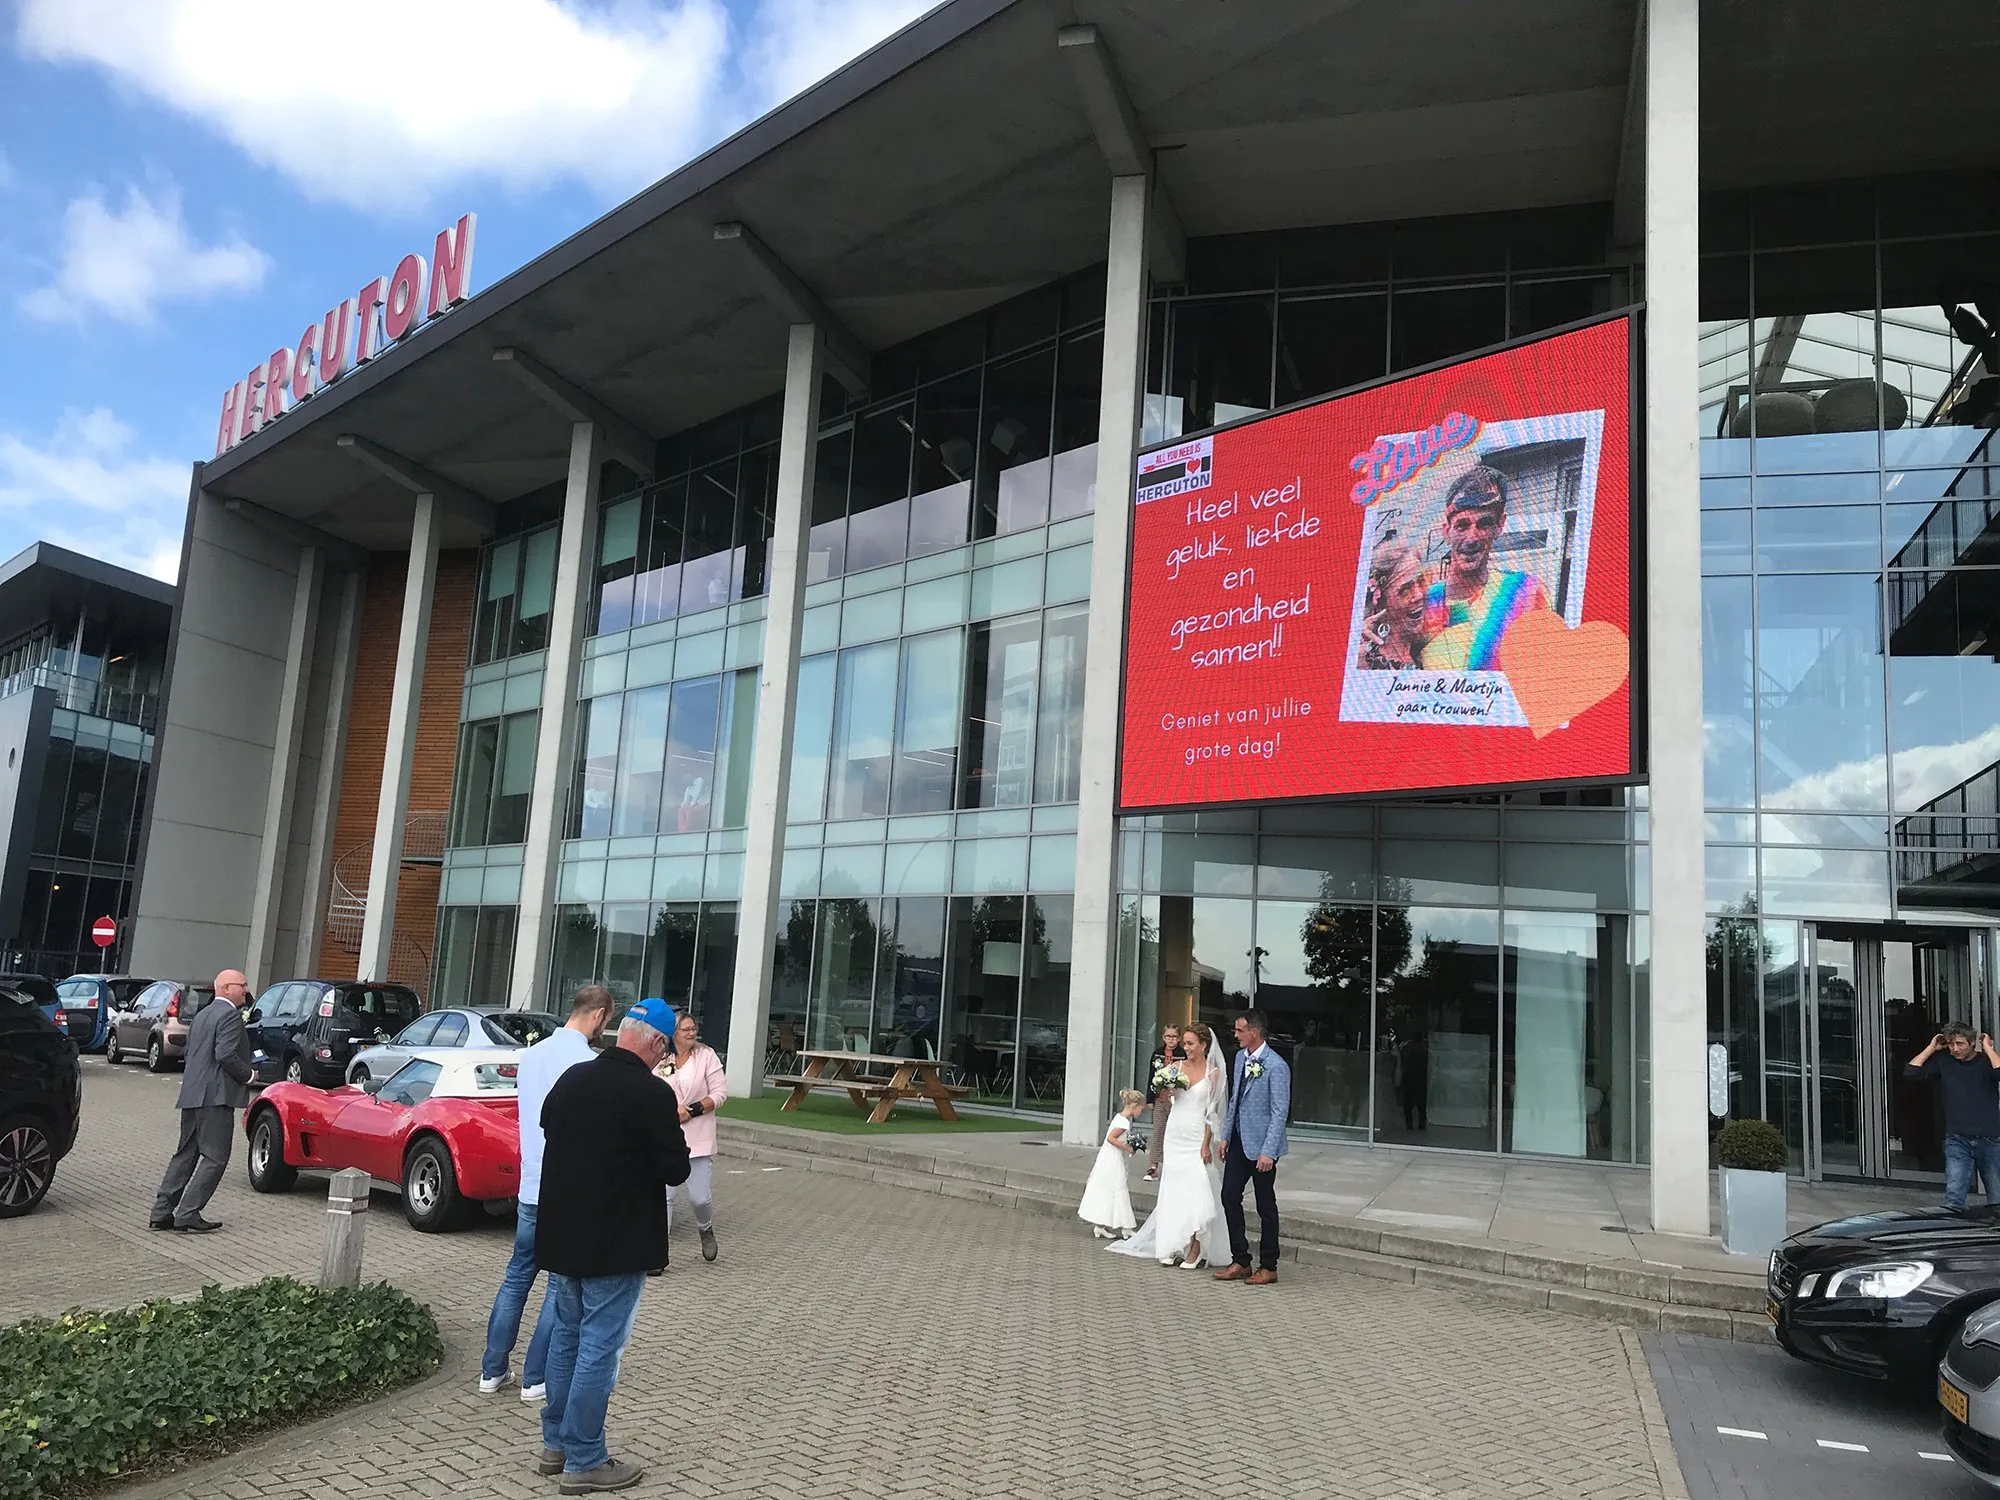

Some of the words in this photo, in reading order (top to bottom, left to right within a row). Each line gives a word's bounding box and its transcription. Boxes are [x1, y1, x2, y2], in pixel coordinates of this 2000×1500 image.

[216, 212, 477, 456] HERCUTON
[1156, 454, 1166, 464] ALL
[1168, 450, 1178, 461] YOU
[1179, 445, 1194, 457] NEED
[1195, 443, 1201, 453] IS
[1349, 411, 1478, 506] Love
[1137, 473, 1210, 503] HERCUTON
[1186, 491, 1238, 525] Heel
[1250, 476, 1301, 510] veel
[1166, 531, 1232, 580] geluk,
[1246, 508, 1320, 549] liefde
[1223, 567, 1254, 590] en
[1170, 583, 1310, 651] gezondheid
[1191, 623, 1283, 669] samen!!
[1386, 677, 1431, 695] Jannie
[1434, 678, 1447, 694] &
[1449, 678, 1503, 698] Martijn
[1161, 710, 1219, 731] Geniet
[1227, 708, 1258, 723] van
[1264, 697, 1312, 725] jullie
[1396, 703, 1427, 717] gaan
[1432, 700, 1494, 716] trouwen!
[1185, 742, 1231, 766] grote
[1238, 732, 1281, 759] dag!
